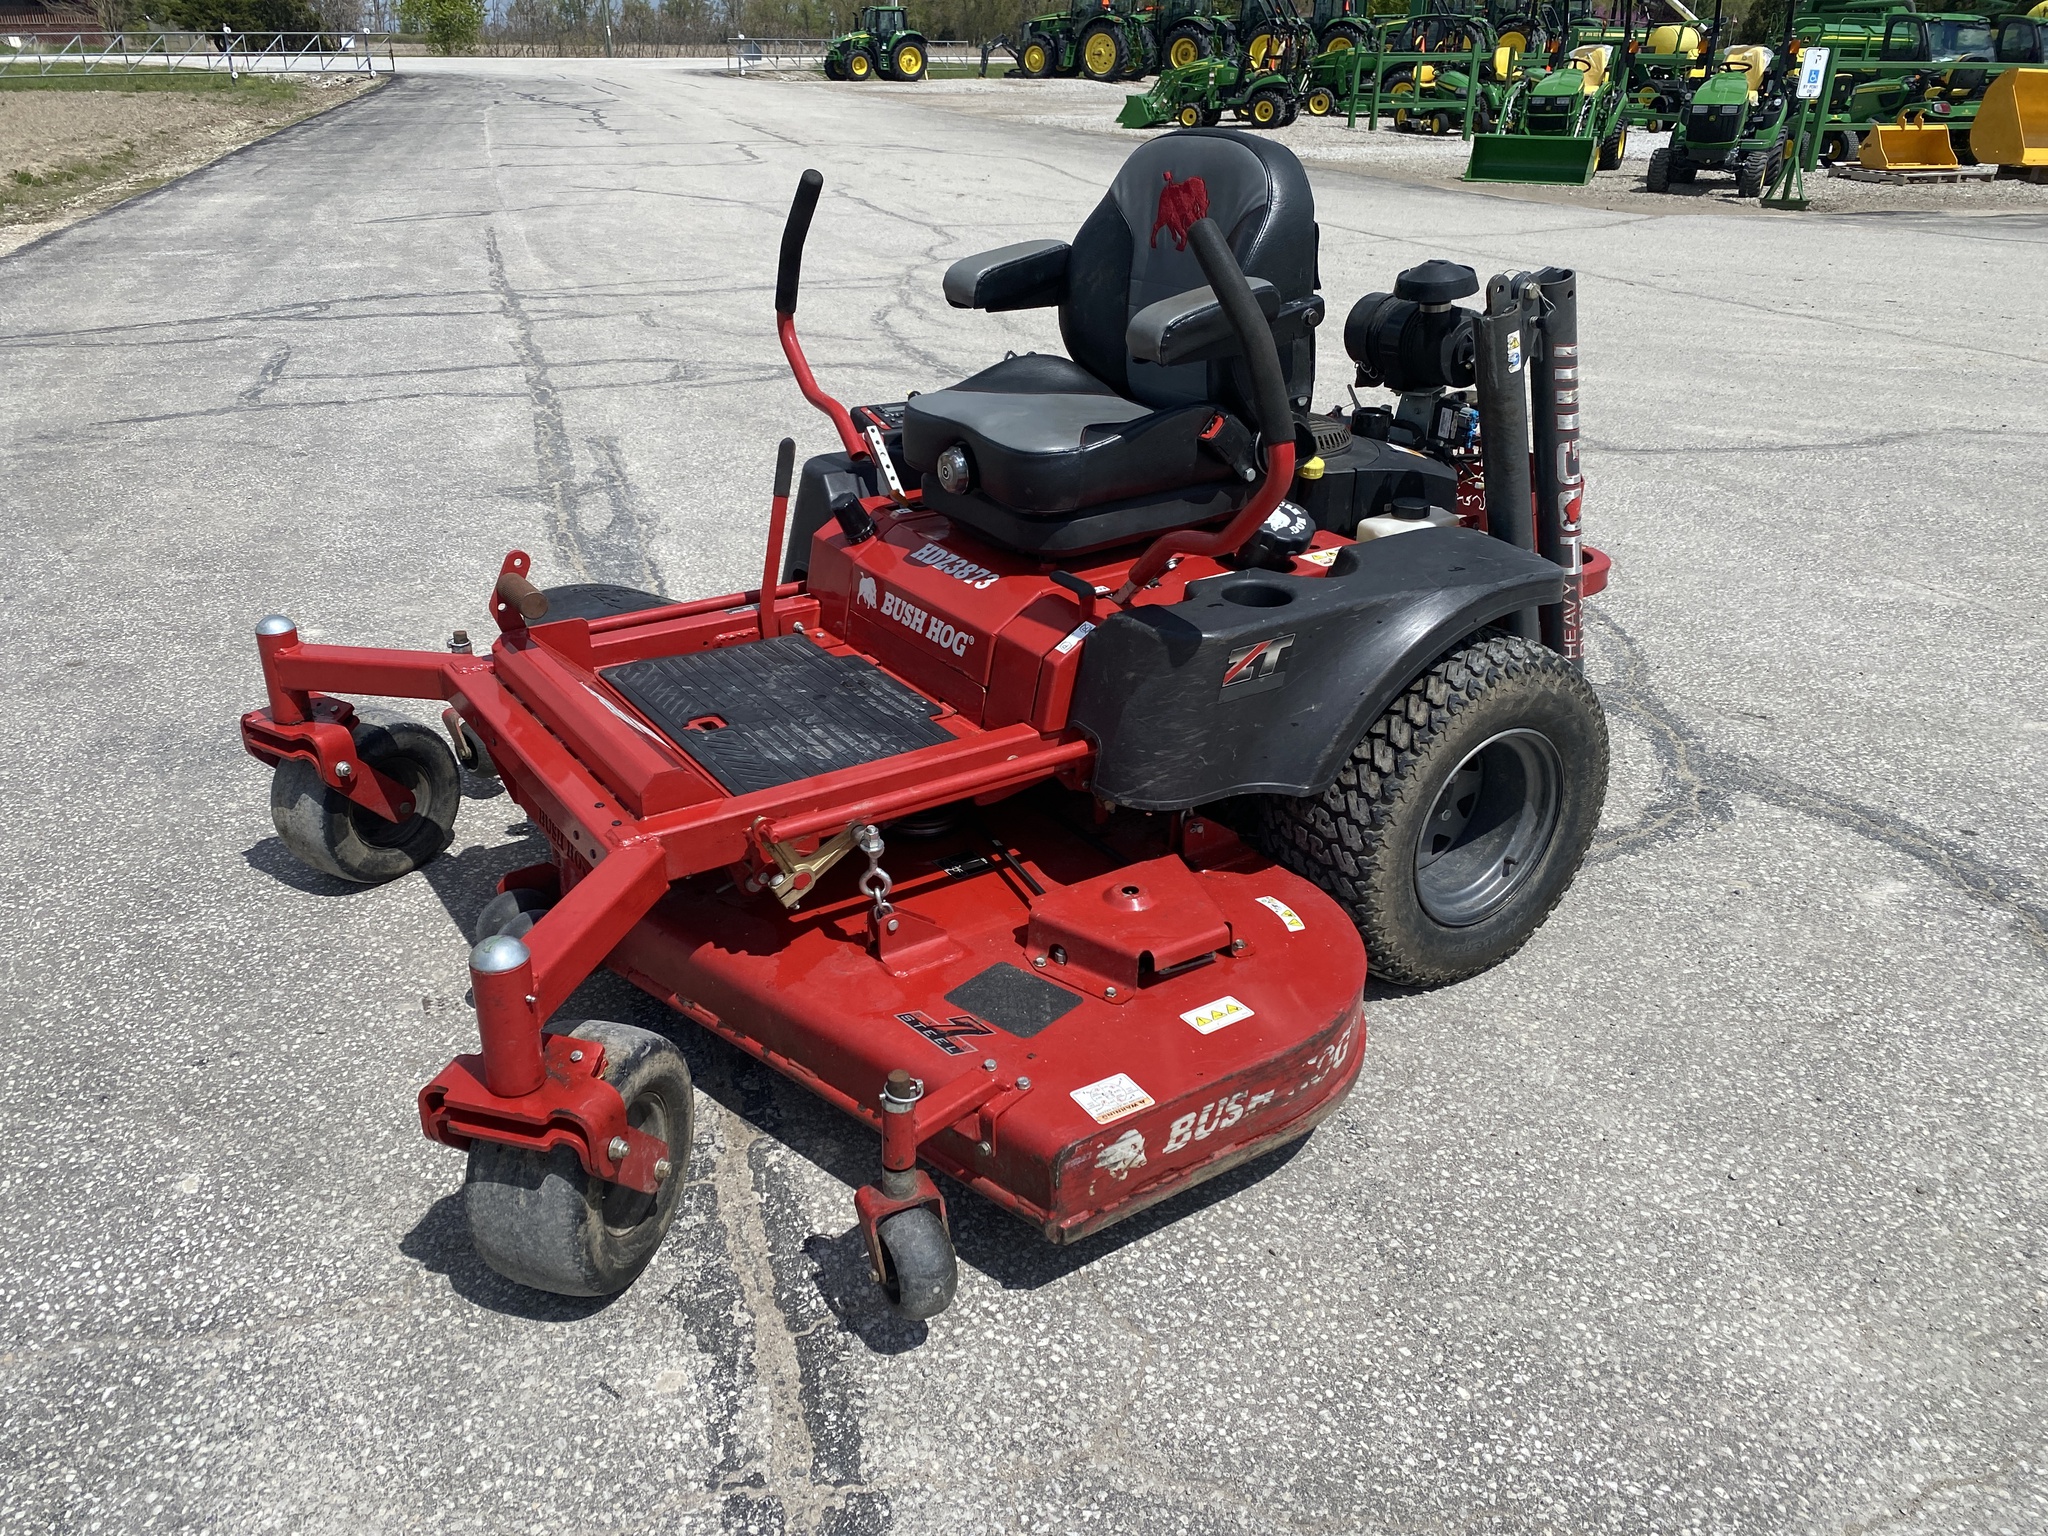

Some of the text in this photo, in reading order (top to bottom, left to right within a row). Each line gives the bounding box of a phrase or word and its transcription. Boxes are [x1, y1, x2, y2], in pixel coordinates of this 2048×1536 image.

[910, 543, 1000, 590] HDZ3873
[880, 591, 928, 635] BUSH
[1562, 582, 1577, 659] HEAVY
[900, 1014, 957, 1054] STEEL
